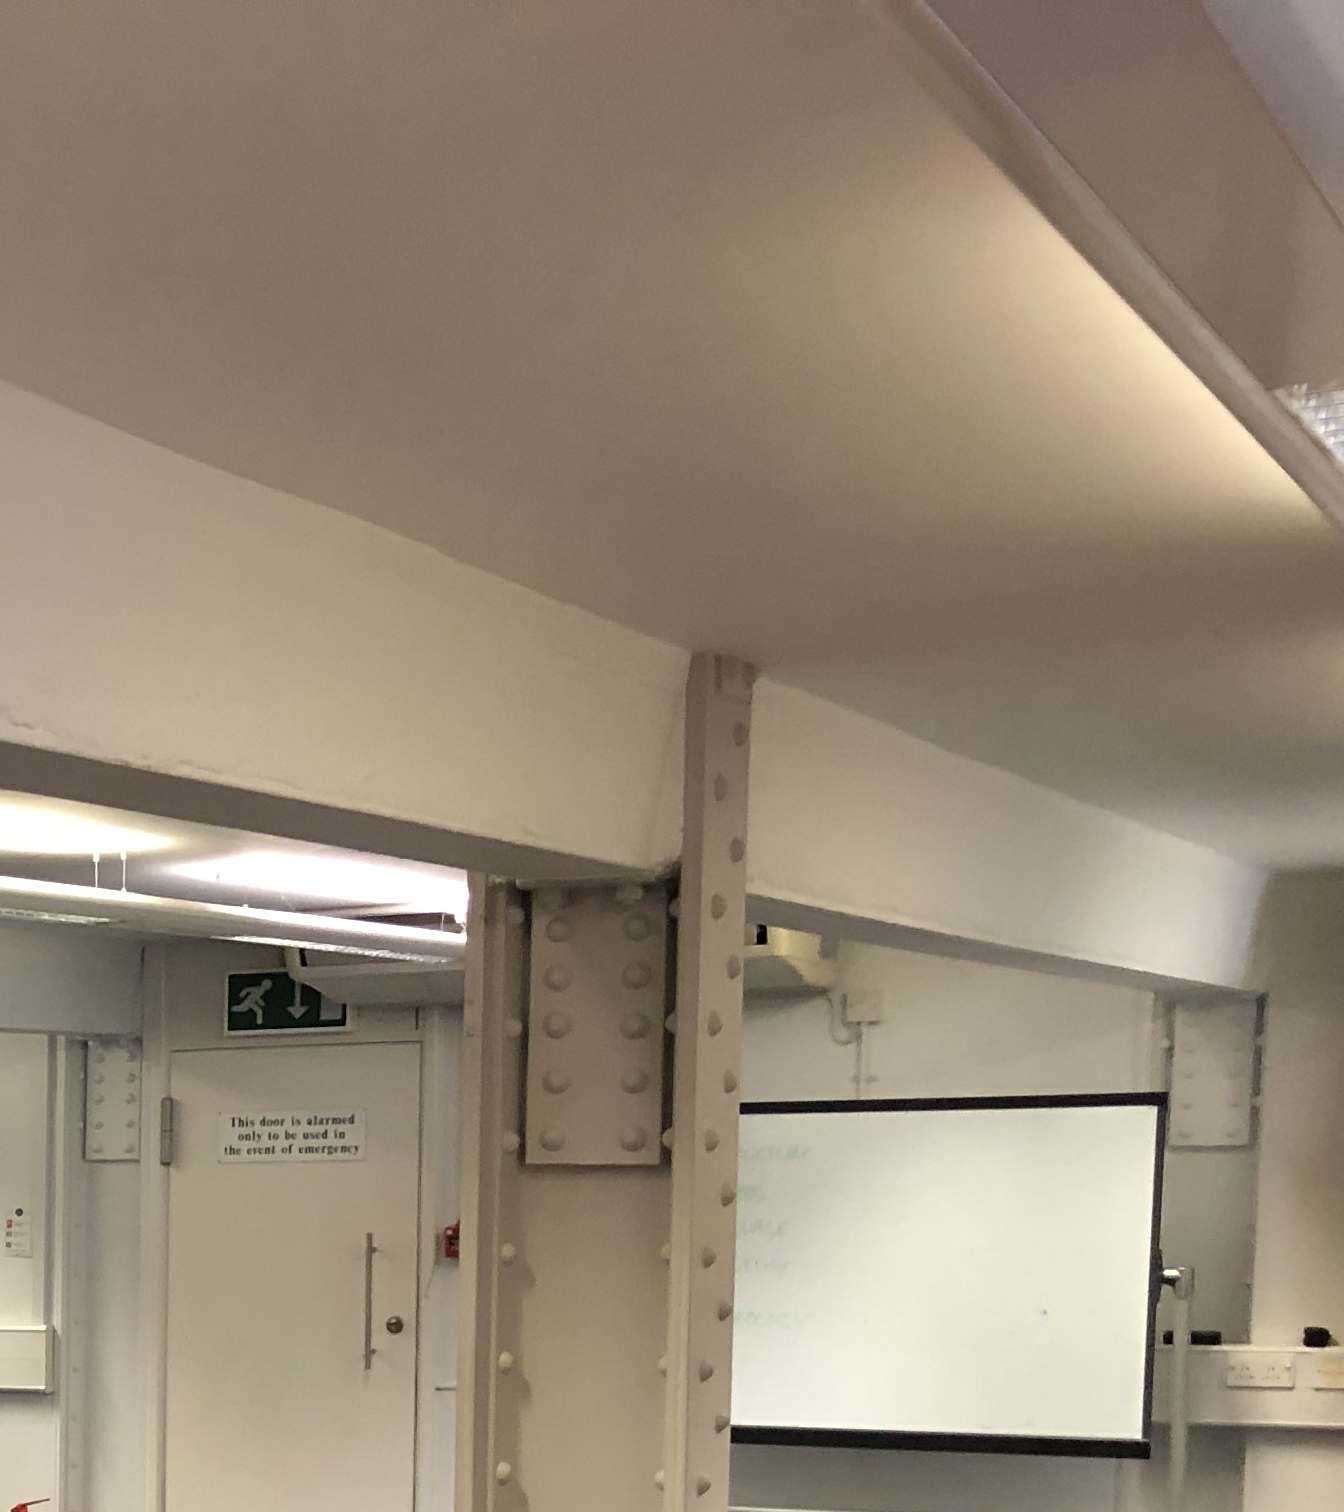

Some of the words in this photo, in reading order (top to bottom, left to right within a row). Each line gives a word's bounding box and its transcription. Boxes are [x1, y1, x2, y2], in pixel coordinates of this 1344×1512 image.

[230, 1117, 255, 1127] This
[260, 1116, 286, 1127] door
[292, 1116, 301, 1126] is
[306, 1114, 355, 1126] alarmed
[237, 1130, 262, 1143] only
[268, 1130, 279, 1141] to
[284, 1129, 297, 1140] be
[303, 1129, 328, 1140] used
[334, 1129, 346, 1139] in
[224, 1145, 241, 1156] the
[246, 1145, 276, 1155] event
[281, 1144, 294, 1154] of
[298, 1145, 359, 1155] emergency
